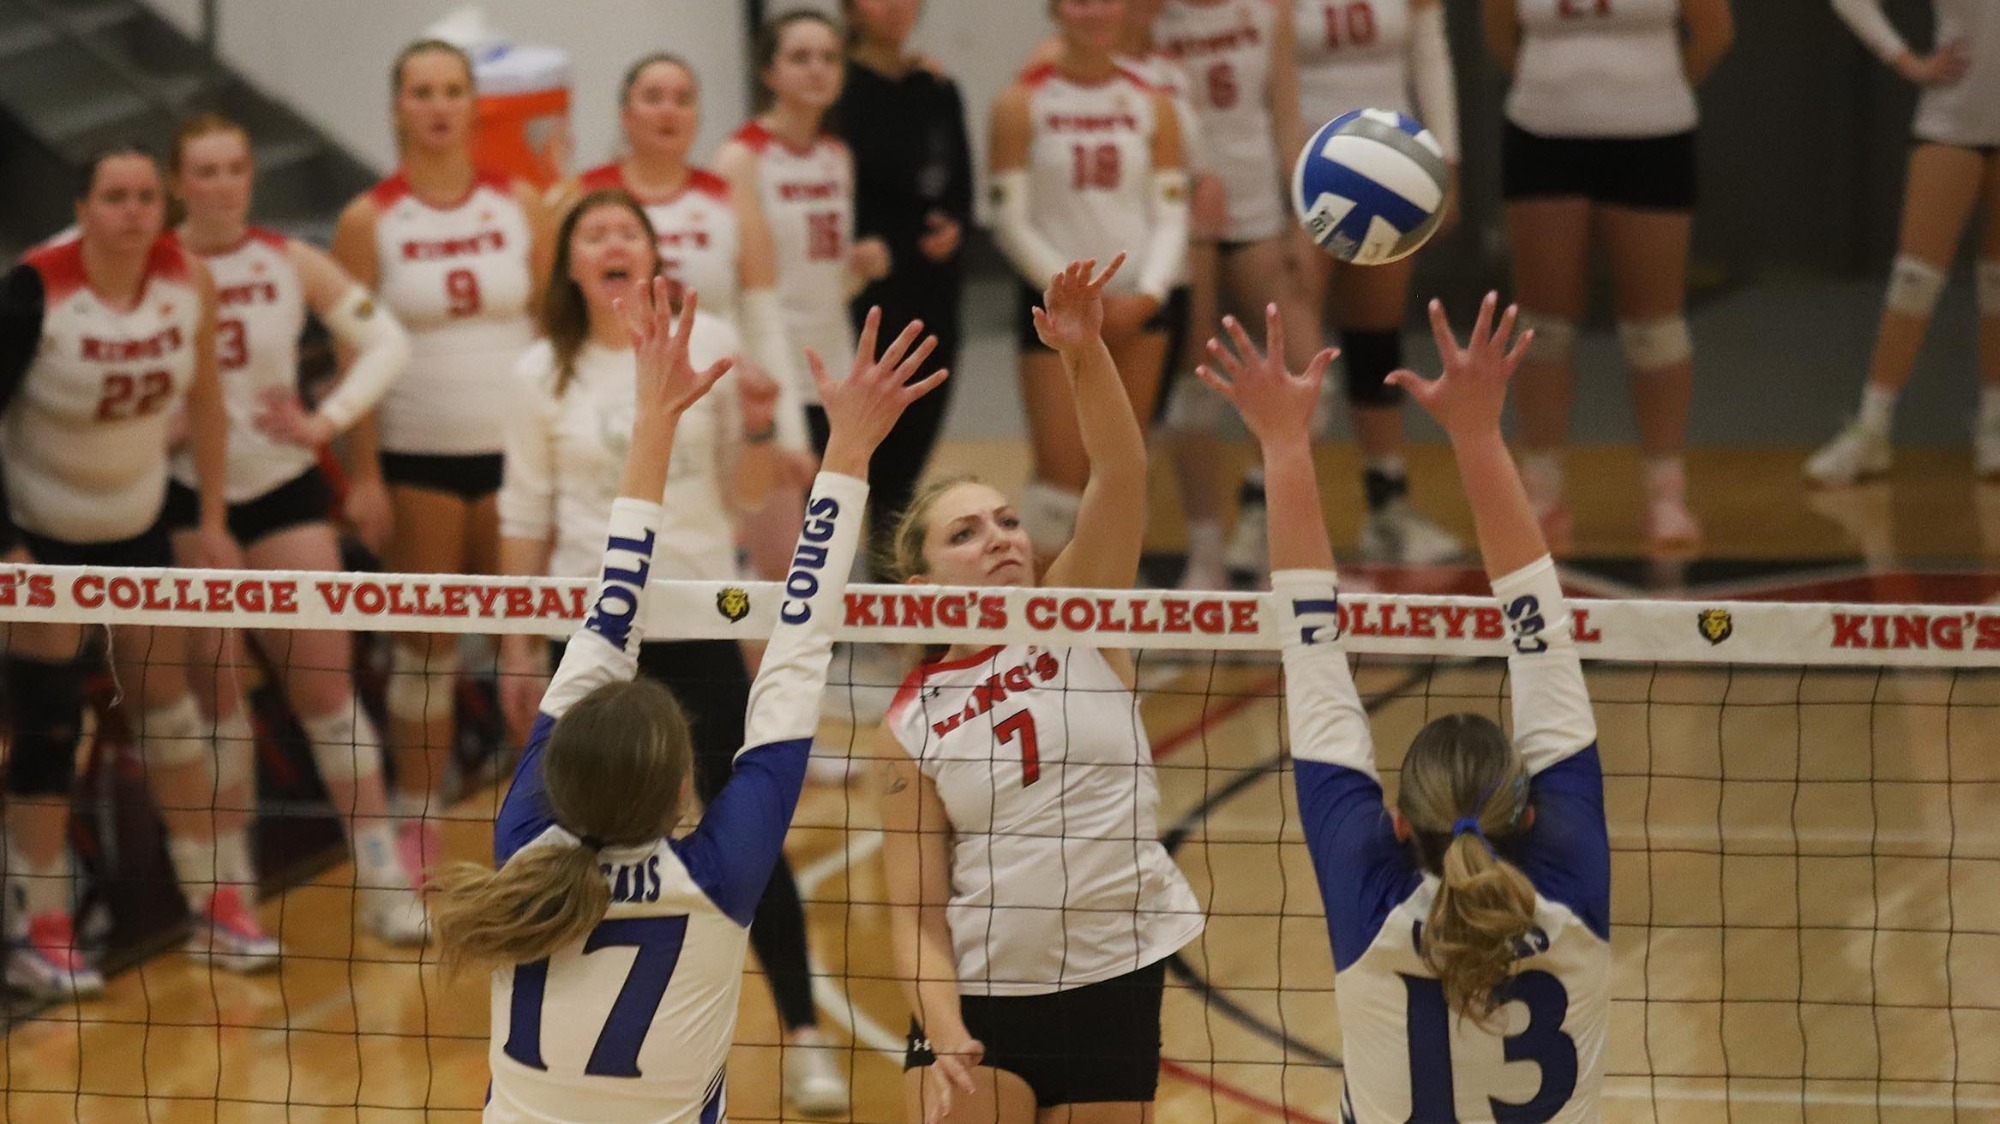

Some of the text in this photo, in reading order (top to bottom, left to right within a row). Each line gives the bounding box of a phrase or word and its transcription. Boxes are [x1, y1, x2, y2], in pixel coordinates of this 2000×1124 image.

[1323, 2, 1377, 49] 10
[445, 268, 483, 319] 9
[95, 369, 174, 422] 22
[780, 496, 840, 626] COUGS
[71, 575, 299, 614] COLLEGE
[842, 591, 1008, 630] KING'S
[1024, 596, 1260, 634] COLLEGE
[1830, 611, 2000, 651] KING'S
[992, 708, 1041, 789] 7
[503, 913, 690, 1078] 17
[1395, 969, 1579, 1124] 13
